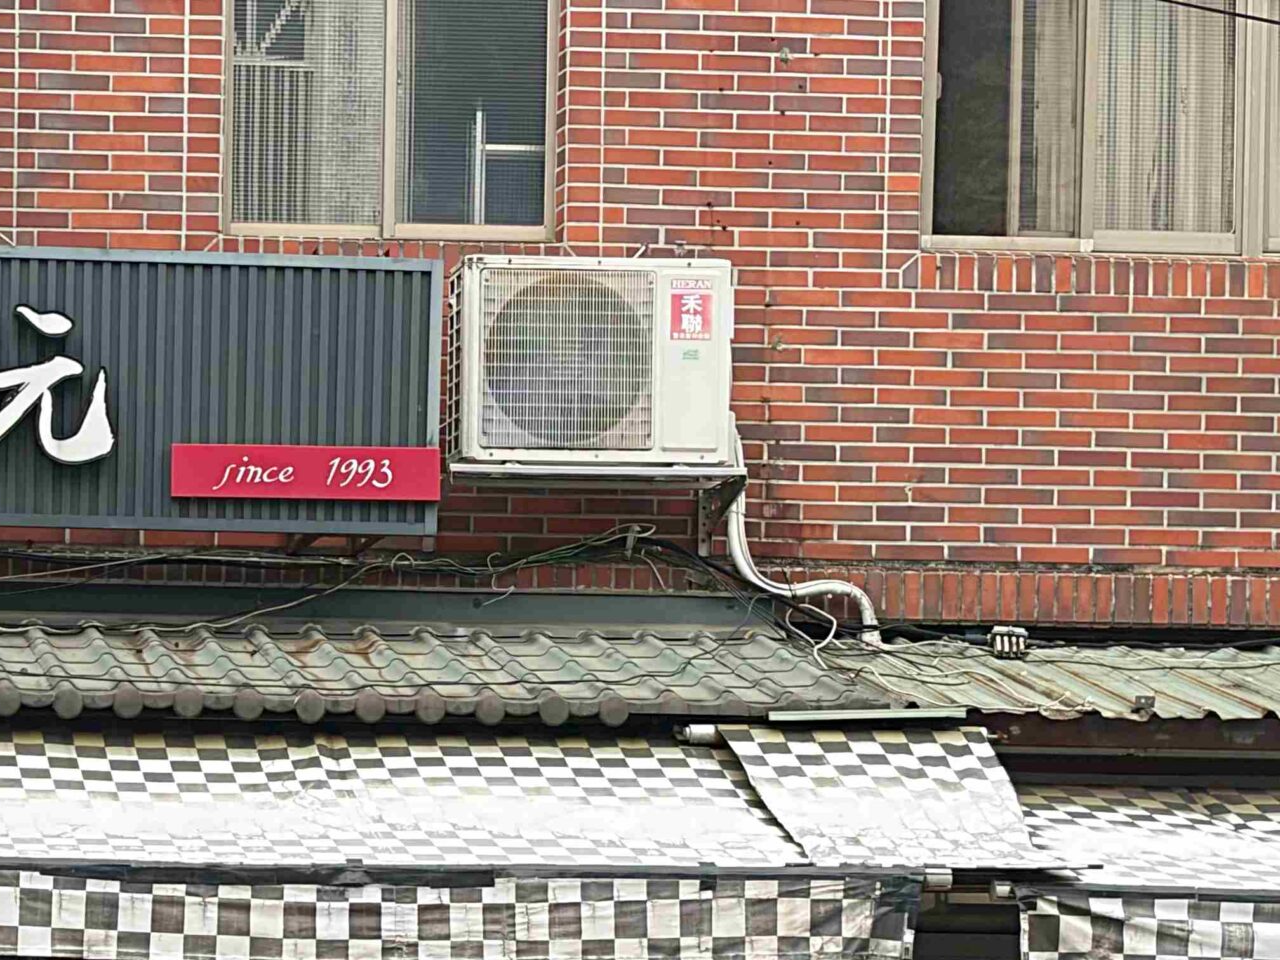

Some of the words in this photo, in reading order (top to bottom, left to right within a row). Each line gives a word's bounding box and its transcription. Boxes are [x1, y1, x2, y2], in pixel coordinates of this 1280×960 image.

[671, 280, 712, 289] HERAN
[681, 295, 703, 334] 禾聯
[325, 456, 394, 489] 1993
